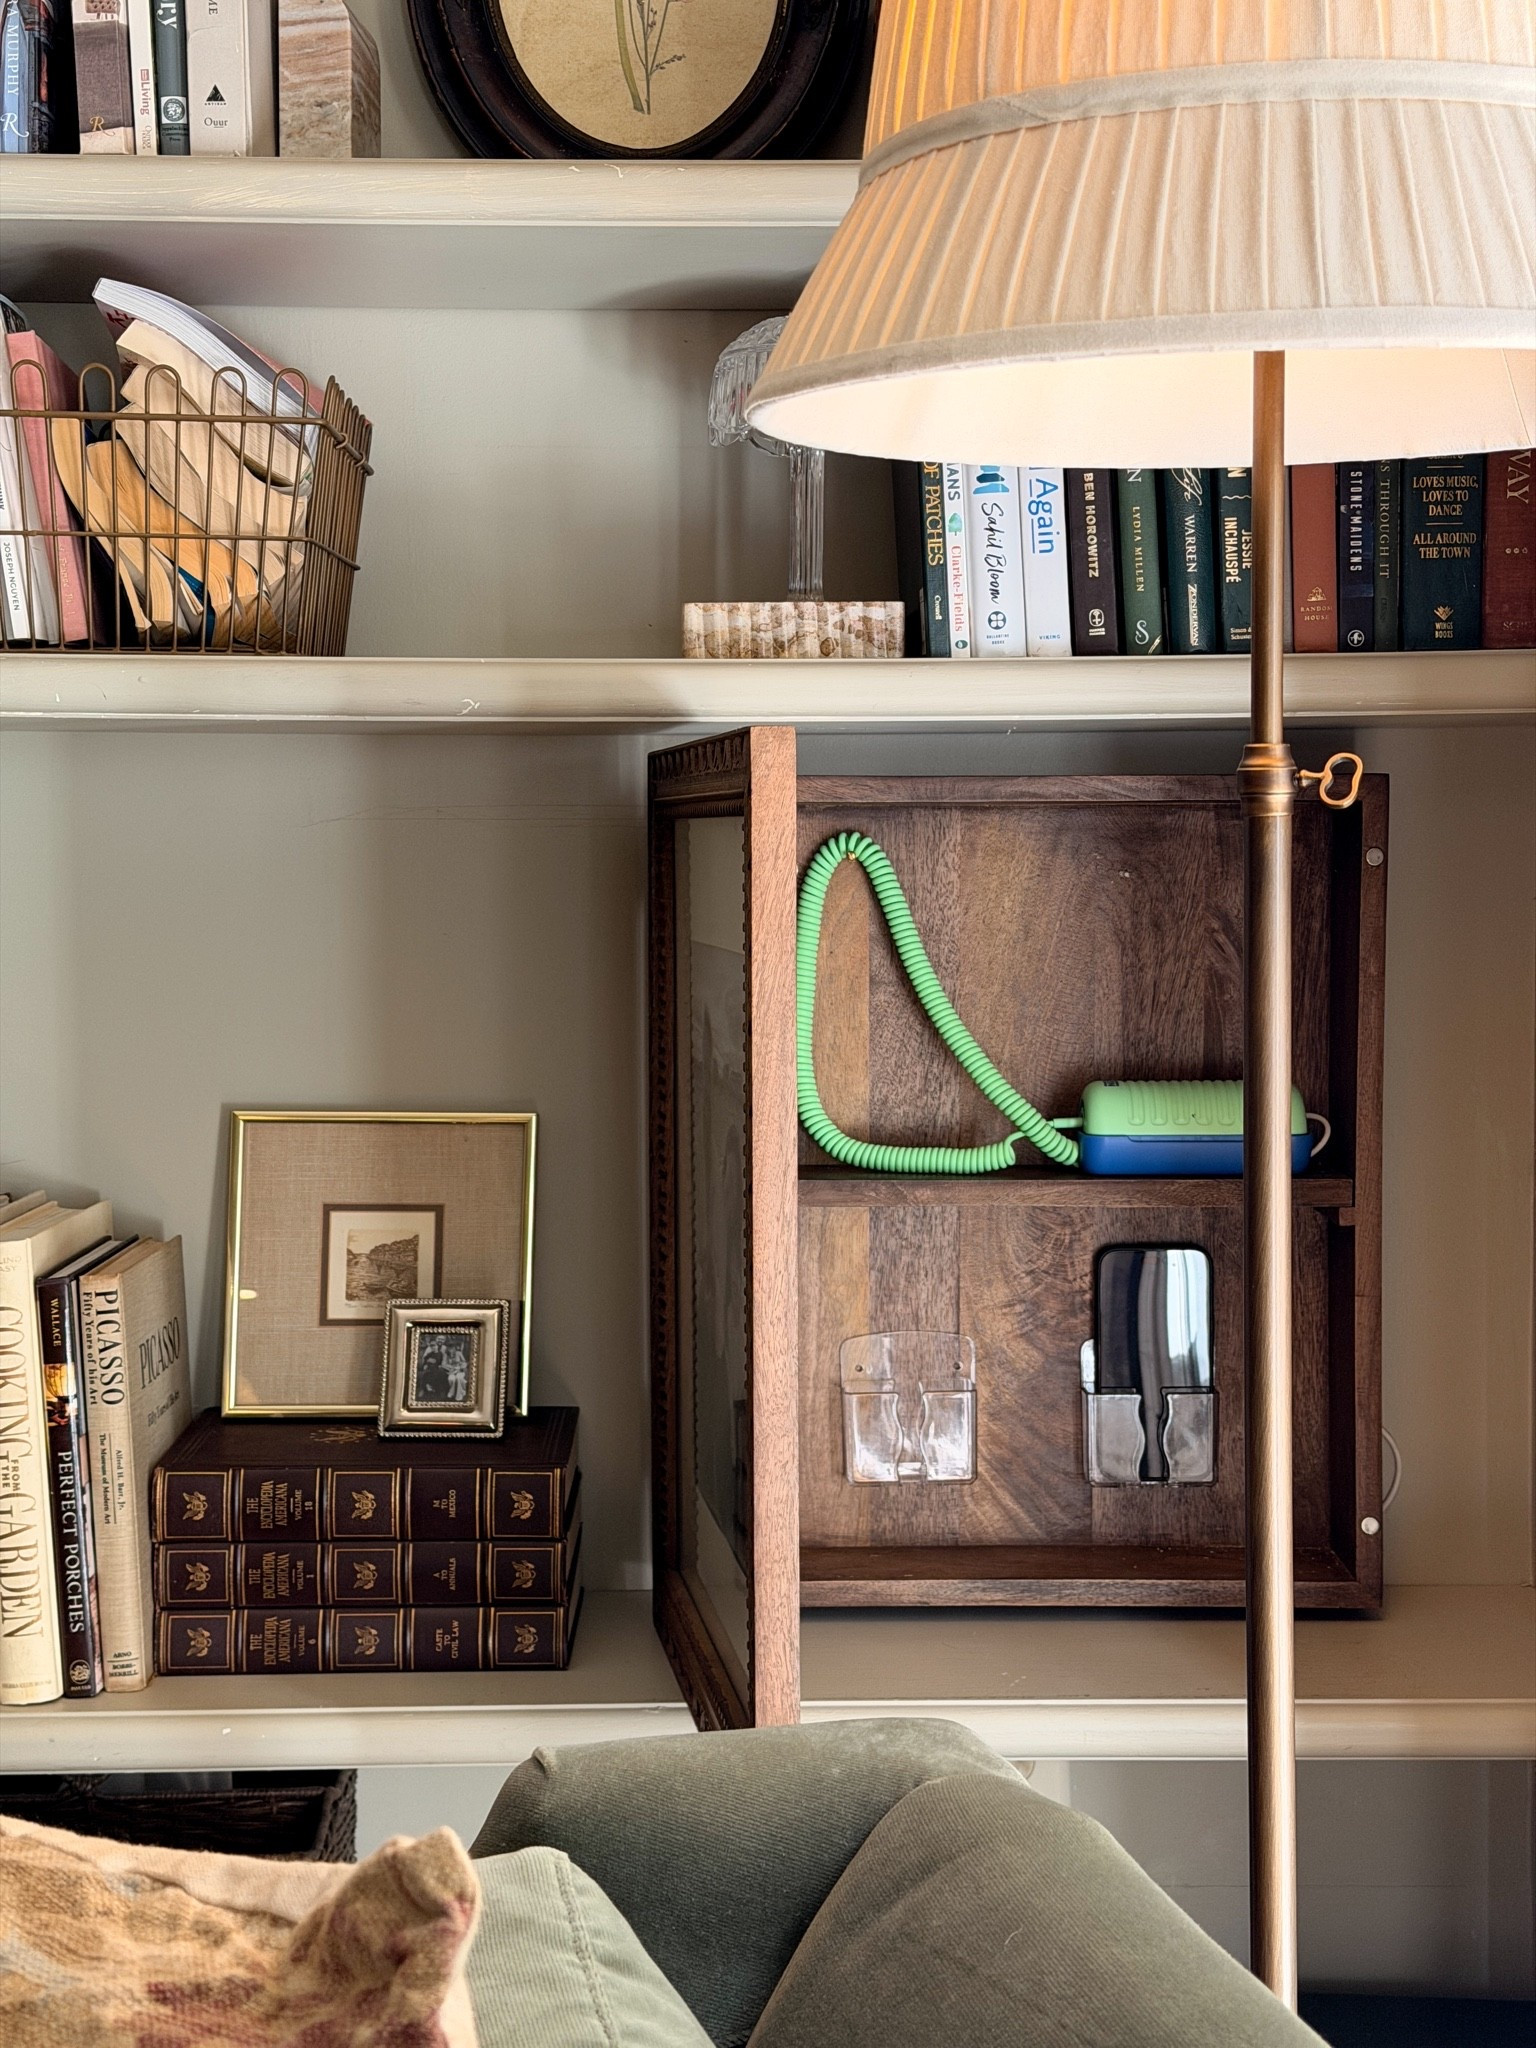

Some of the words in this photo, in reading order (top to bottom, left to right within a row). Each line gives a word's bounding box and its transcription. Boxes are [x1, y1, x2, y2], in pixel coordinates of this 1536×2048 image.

[7, 25, 19, 96] MURPHY
[140, 82, 151, 116] Living
[203, 117, 229, 128] Ouur
[1083, 472, 1095, 501] BEN
[1350, 471, 1363, 510] STONE
[1412, 476, 1445, 488] LOVES
[1446, 475, 1479, 489] MUSIC,
[1422, 490, 1455, 502] LOVES
[1455, 490, 1469, 501] TO
[981, 502, 1005, 549] Sahil
[1028, 478, 1061, 555] Again
[1132, 506, 1142, 542] LYDIA
[1379, 479, 1390, 556] THROUGH
[1428, 504, 1463, 516] DANCE
[924, 485, 945, 567] PATCHES
[1085, 505, 1100, 578] HOROWITZ
[1412, 533, 1433, 545] ALL
[1433, 532, 1477, 544] AROUND
[1184, 515, 1198, 573] WARREN
[1223, 516, 1242, 583] INCHAUSPÉ
[1241, 529, 1252, 570] JESSIE
[1350, 515, 1363, 572] MAIDENS
[1418, 547, 1440, 559] THE
[1440, 546, 1471, 559] TOWN
[3, 541, 15, 575] JOSEPH
[9, 576, 20, 611] NGUYEN
[983, 553, 1007, 605] Bloom
[1134, 547, 1145, 592] MILLEN
[1379, 564, 1390, 578] IT
[950, 545, 965, 632] Clarke-Fields
[1187, 583, 1200, 647] ZONDERVAN
[1230, 626, 1247, 634] Simon
[83, 1291, 93, 1318] Fifty
[50, 1298, 62, 1347] WALLACE
[84, 1320, 93, 1350] Years
[87, 1353, 97, 1365] of
[95, 1288, 125, 1406] PICASSO
[138, 1316, 180, 1390] PICASSO
[0, 1306, 33, 1458] COOKING
[88, 1368, 98, 1388] his
[88, 1389, 99, 1406] Art
[99, 1434, 107, 1447] The
[0, 1450, 11, 1489] THE
[11, 1459, 21, 1492] FROM
[100, 1448, 108, 1476] Museum
[115, 1449, 124, 1471] Alfred
[57, 1450, 78, 1537] PERFECT
[102, 1477, 110, 1485] of
[102, 1486, 111, 1512] Modern
[117, 1501, 126, 1511] Jr.
[247, 1497, 259, 1514] THE
[261, 1480, 275, 1529] ENCYCLOPEDIA
[274, 1482, 288, 1527] AMERICANA
[294, 1489, 303, 1520] VOLUME
[441, 1498, 448, 1510] TO
[449, 1489, 457, 1518] MEXICO
[104, 1513, 112, 1525] Art
[0, 1492, 44, 1638] GARDEN
[249, 1568, 261, 1585] THE
[262, 1551, 276, 1599] ENCYCLOPEDIA
[276, 1553, 290, 1597] AMERICANA
[296, 1560, 305, 1590] VOLUME
[441, 1569, 448, 1581] TO
[64, 1545, 85, 1633] PORCHES
[250, 1633, 263, 1651] THE
[264, 1616, 278, 1666] ENCYCLOPEDIA
[278, 1618, 292, 1663] AMERICANA
[298, 1625, 306, 1656] VOLUME
[308, 1637, 317, 1646] 6
[444, 1634, 451, 1646] TO
[451, 1619, 460, 1638] LAW
[113, 1651, 132, 1659] ARNO
[451, 1639, 460, 1659] CIVIL
